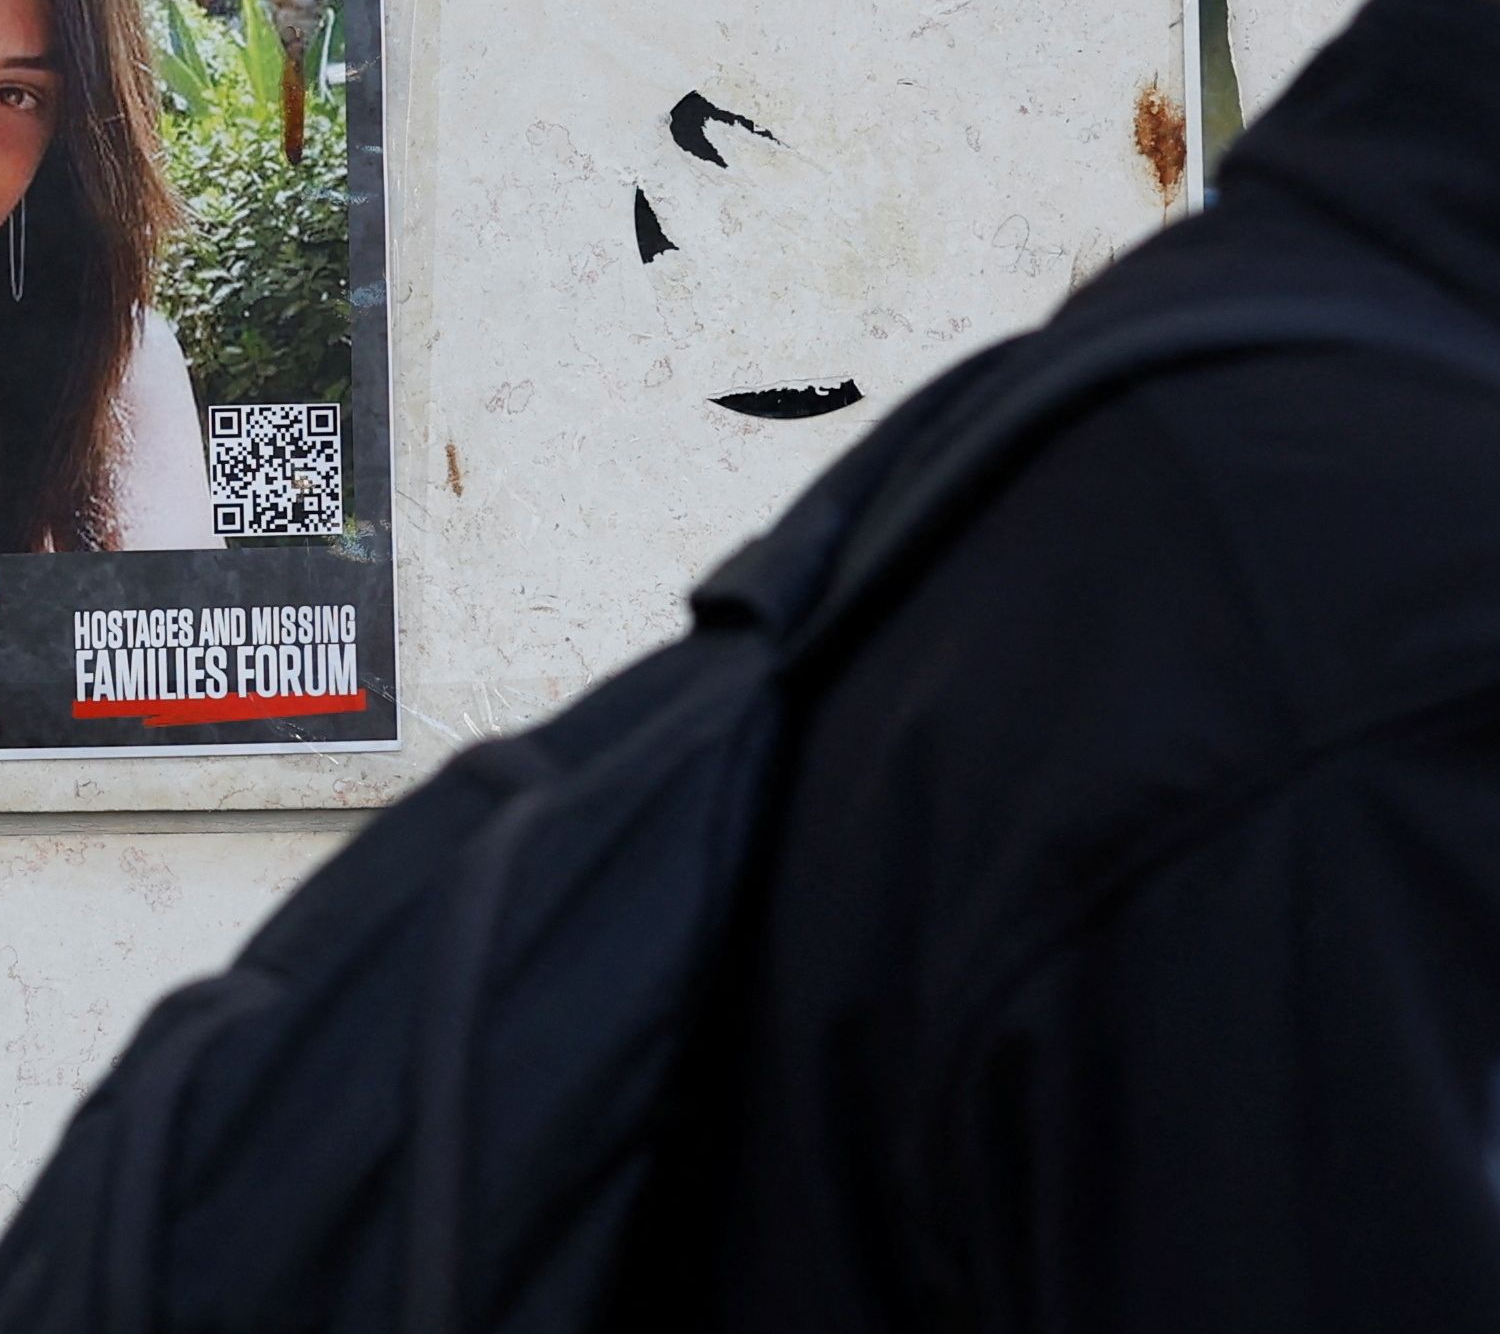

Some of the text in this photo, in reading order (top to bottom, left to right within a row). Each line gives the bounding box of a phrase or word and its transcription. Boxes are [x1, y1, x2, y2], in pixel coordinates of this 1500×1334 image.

[74, 604, 356, 650] HOSTAGES AND MISSING
[75, 643, 358, 702] FAMILIES FORUM
